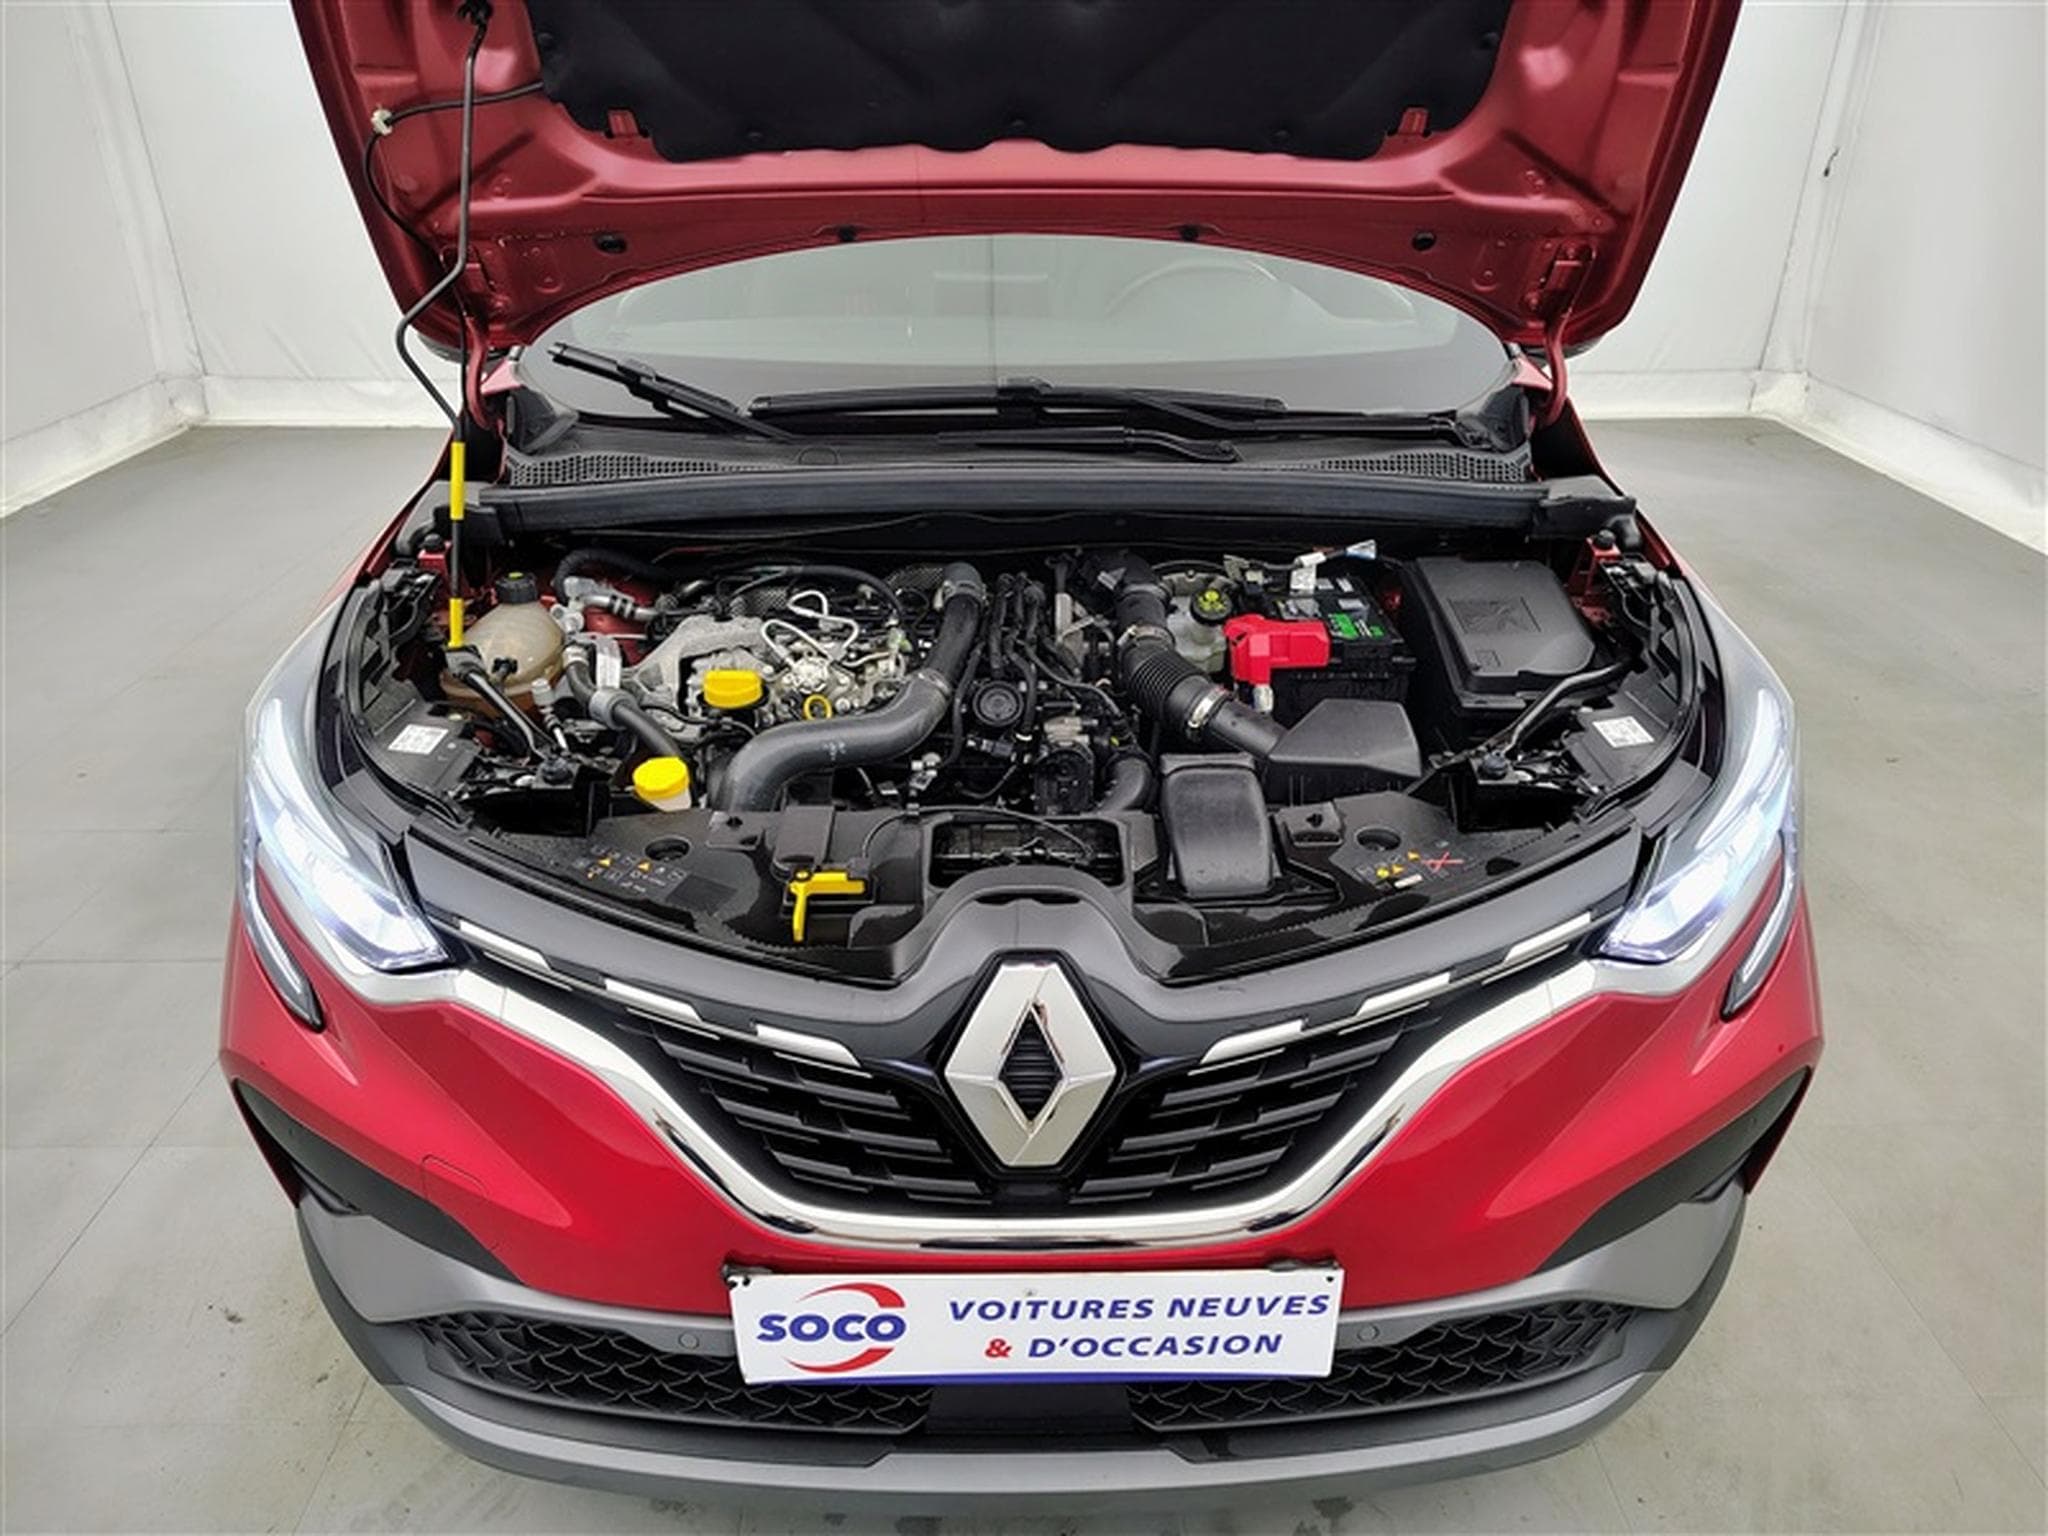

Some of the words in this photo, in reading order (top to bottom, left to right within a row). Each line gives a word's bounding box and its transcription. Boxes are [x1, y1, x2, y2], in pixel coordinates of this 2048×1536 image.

[950, 1298, 1154, 1321] VOITURES
[1168, 1294, 1331, 1318] NEUVES
[757, 1313, 906, 1342] SOCO
[985, 1338, 1011, 1359] &
[1028, 1333, 1283, 1359] D'OCCASION
